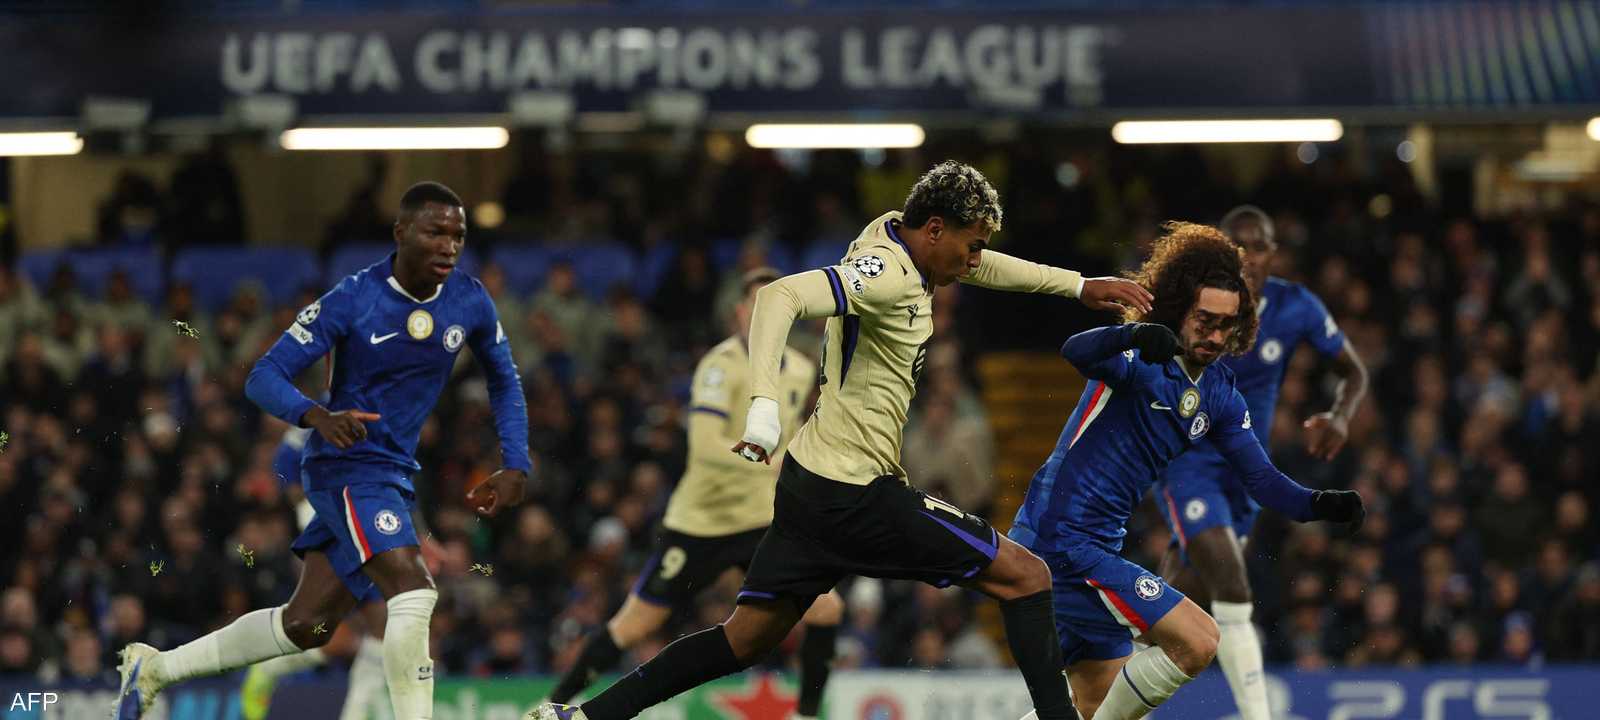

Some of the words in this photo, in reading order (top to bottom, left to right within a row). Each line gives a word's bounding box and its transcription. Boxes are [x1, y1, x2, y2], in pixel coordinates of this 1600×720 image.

[222, 32, 400, 94] UEFA
[414, 28, 821, 92] CHAMPIONS
[841, 26, 1103, 94] LEAGUE
[661, 547, 687, 580] 9
